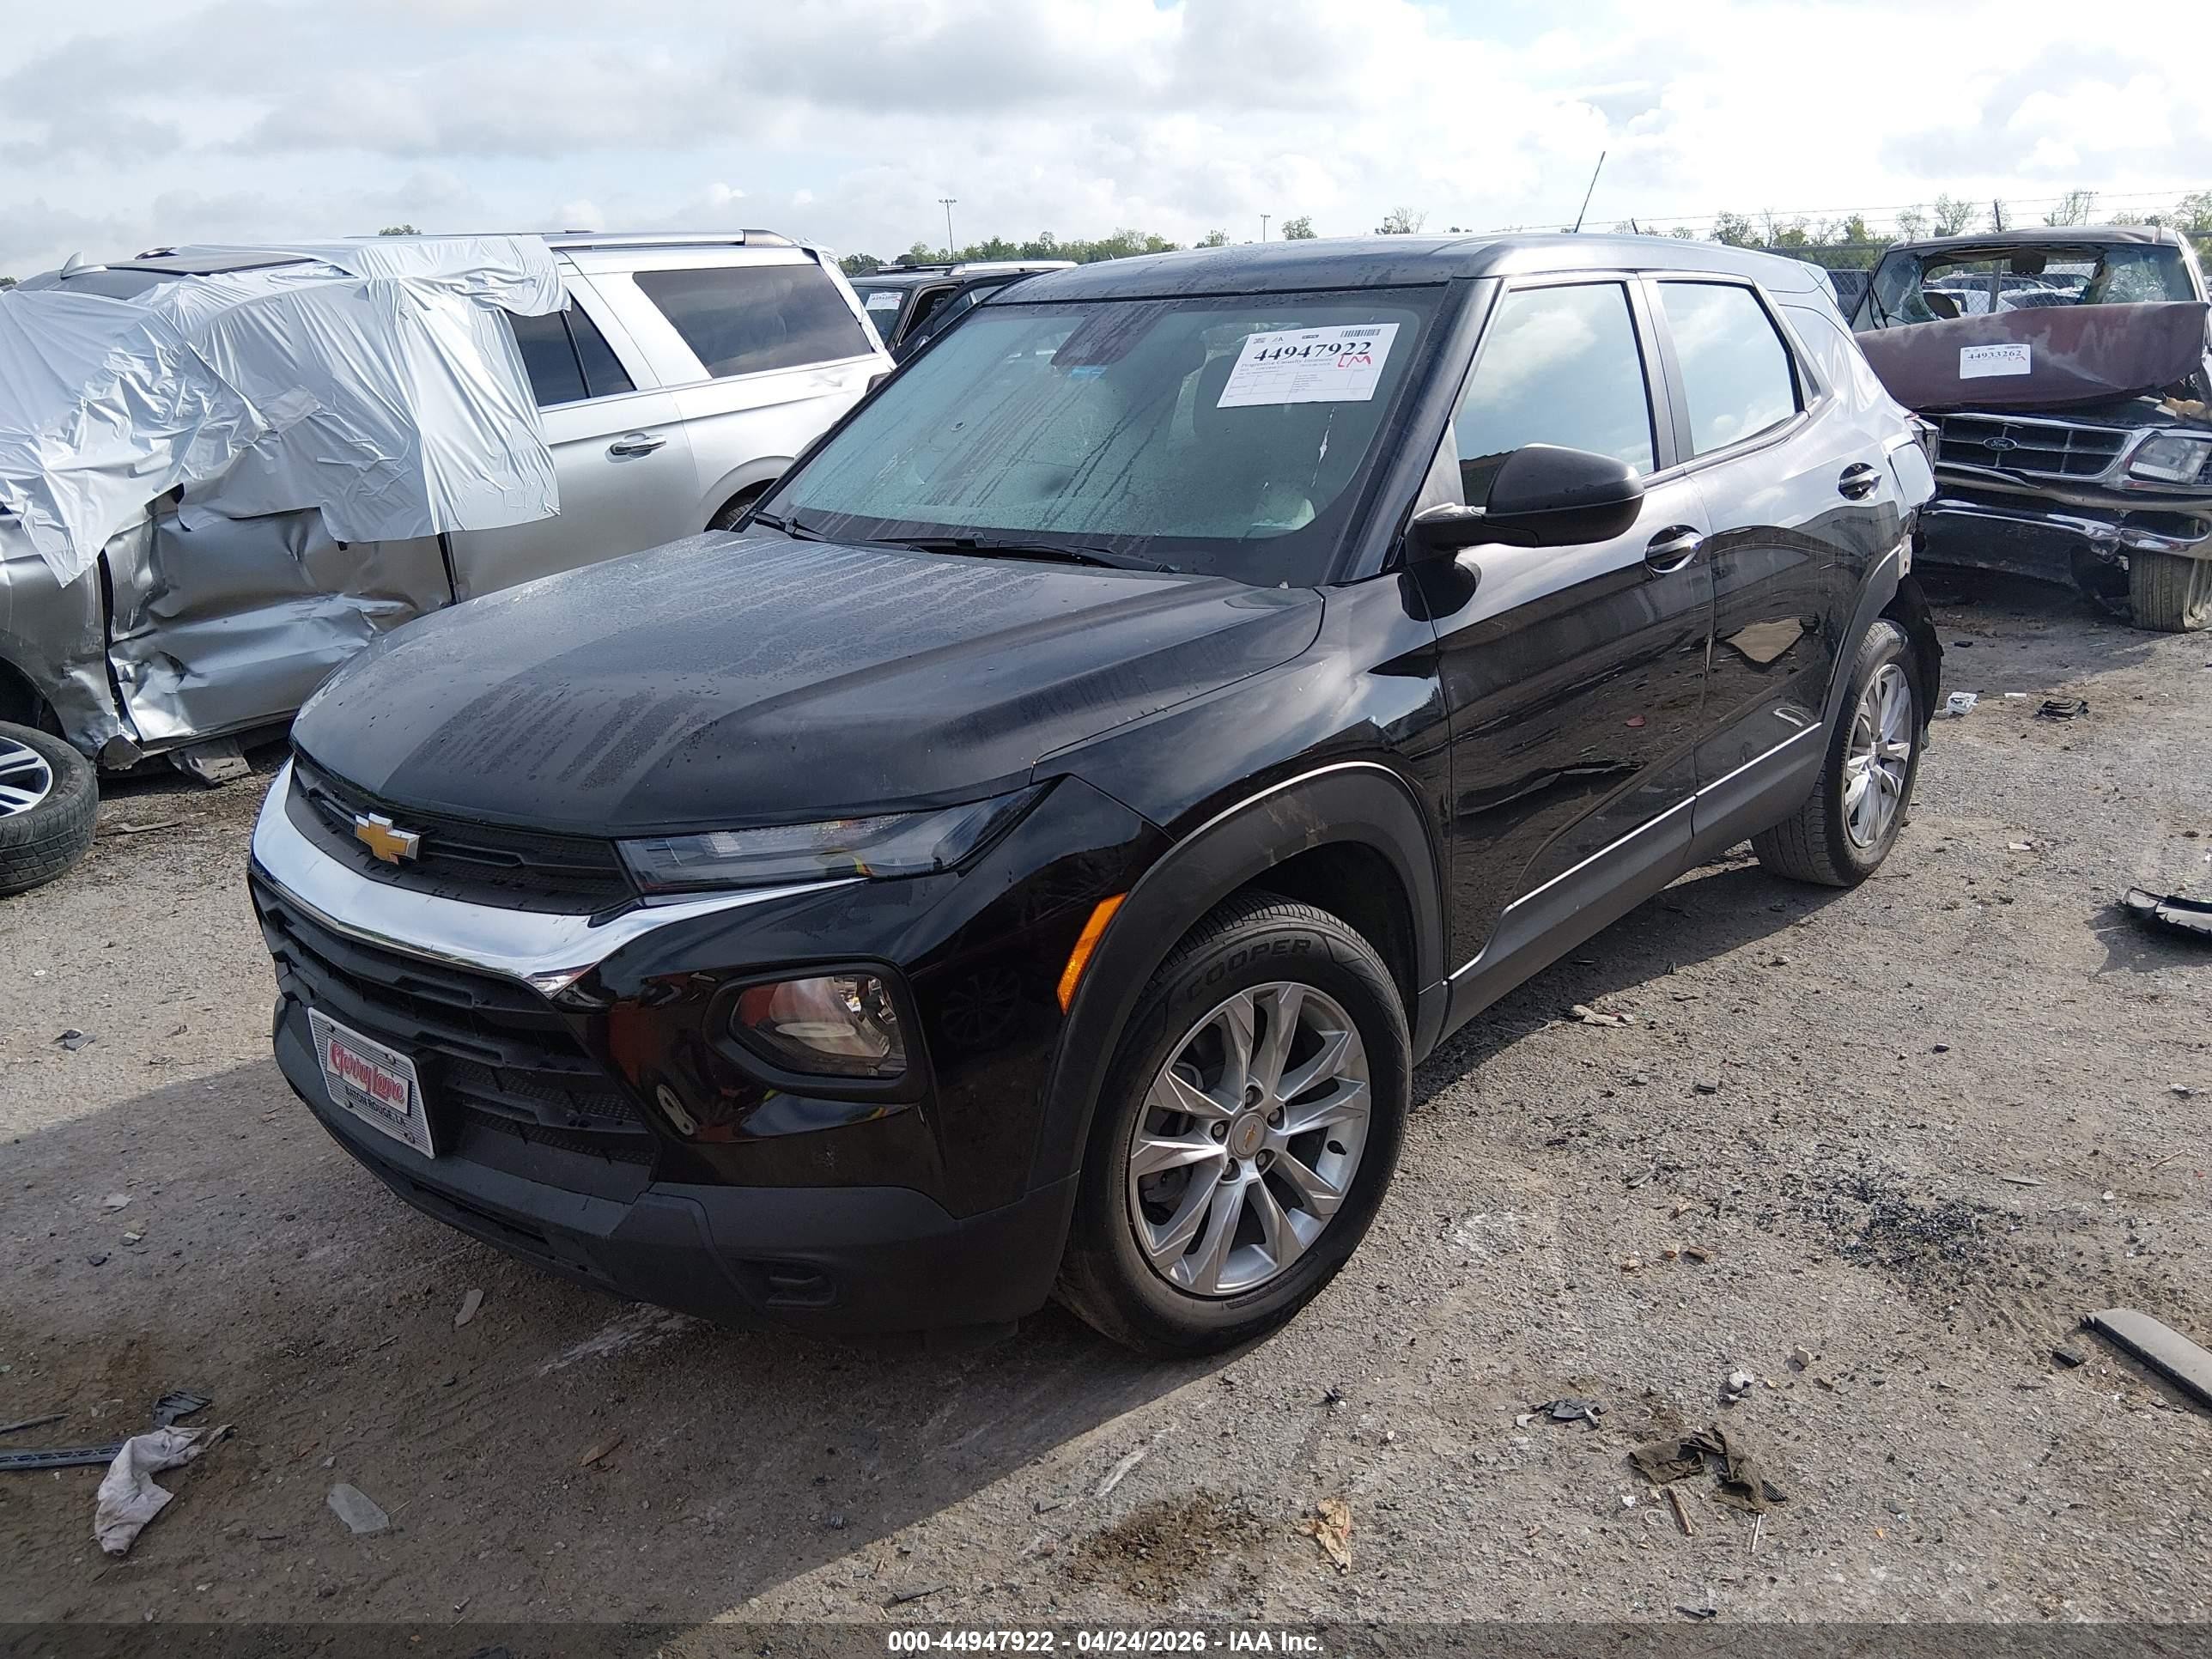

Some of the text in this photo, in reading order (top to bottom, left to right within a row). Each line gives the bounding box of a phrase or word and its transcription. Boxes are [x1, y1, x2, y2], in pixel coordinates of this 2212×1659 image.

[1253, 341, 1372, 362] 44947922
[1967, 349, 2022, 360] 44933262
[1185, 939, 1311, 1003] COOPER
